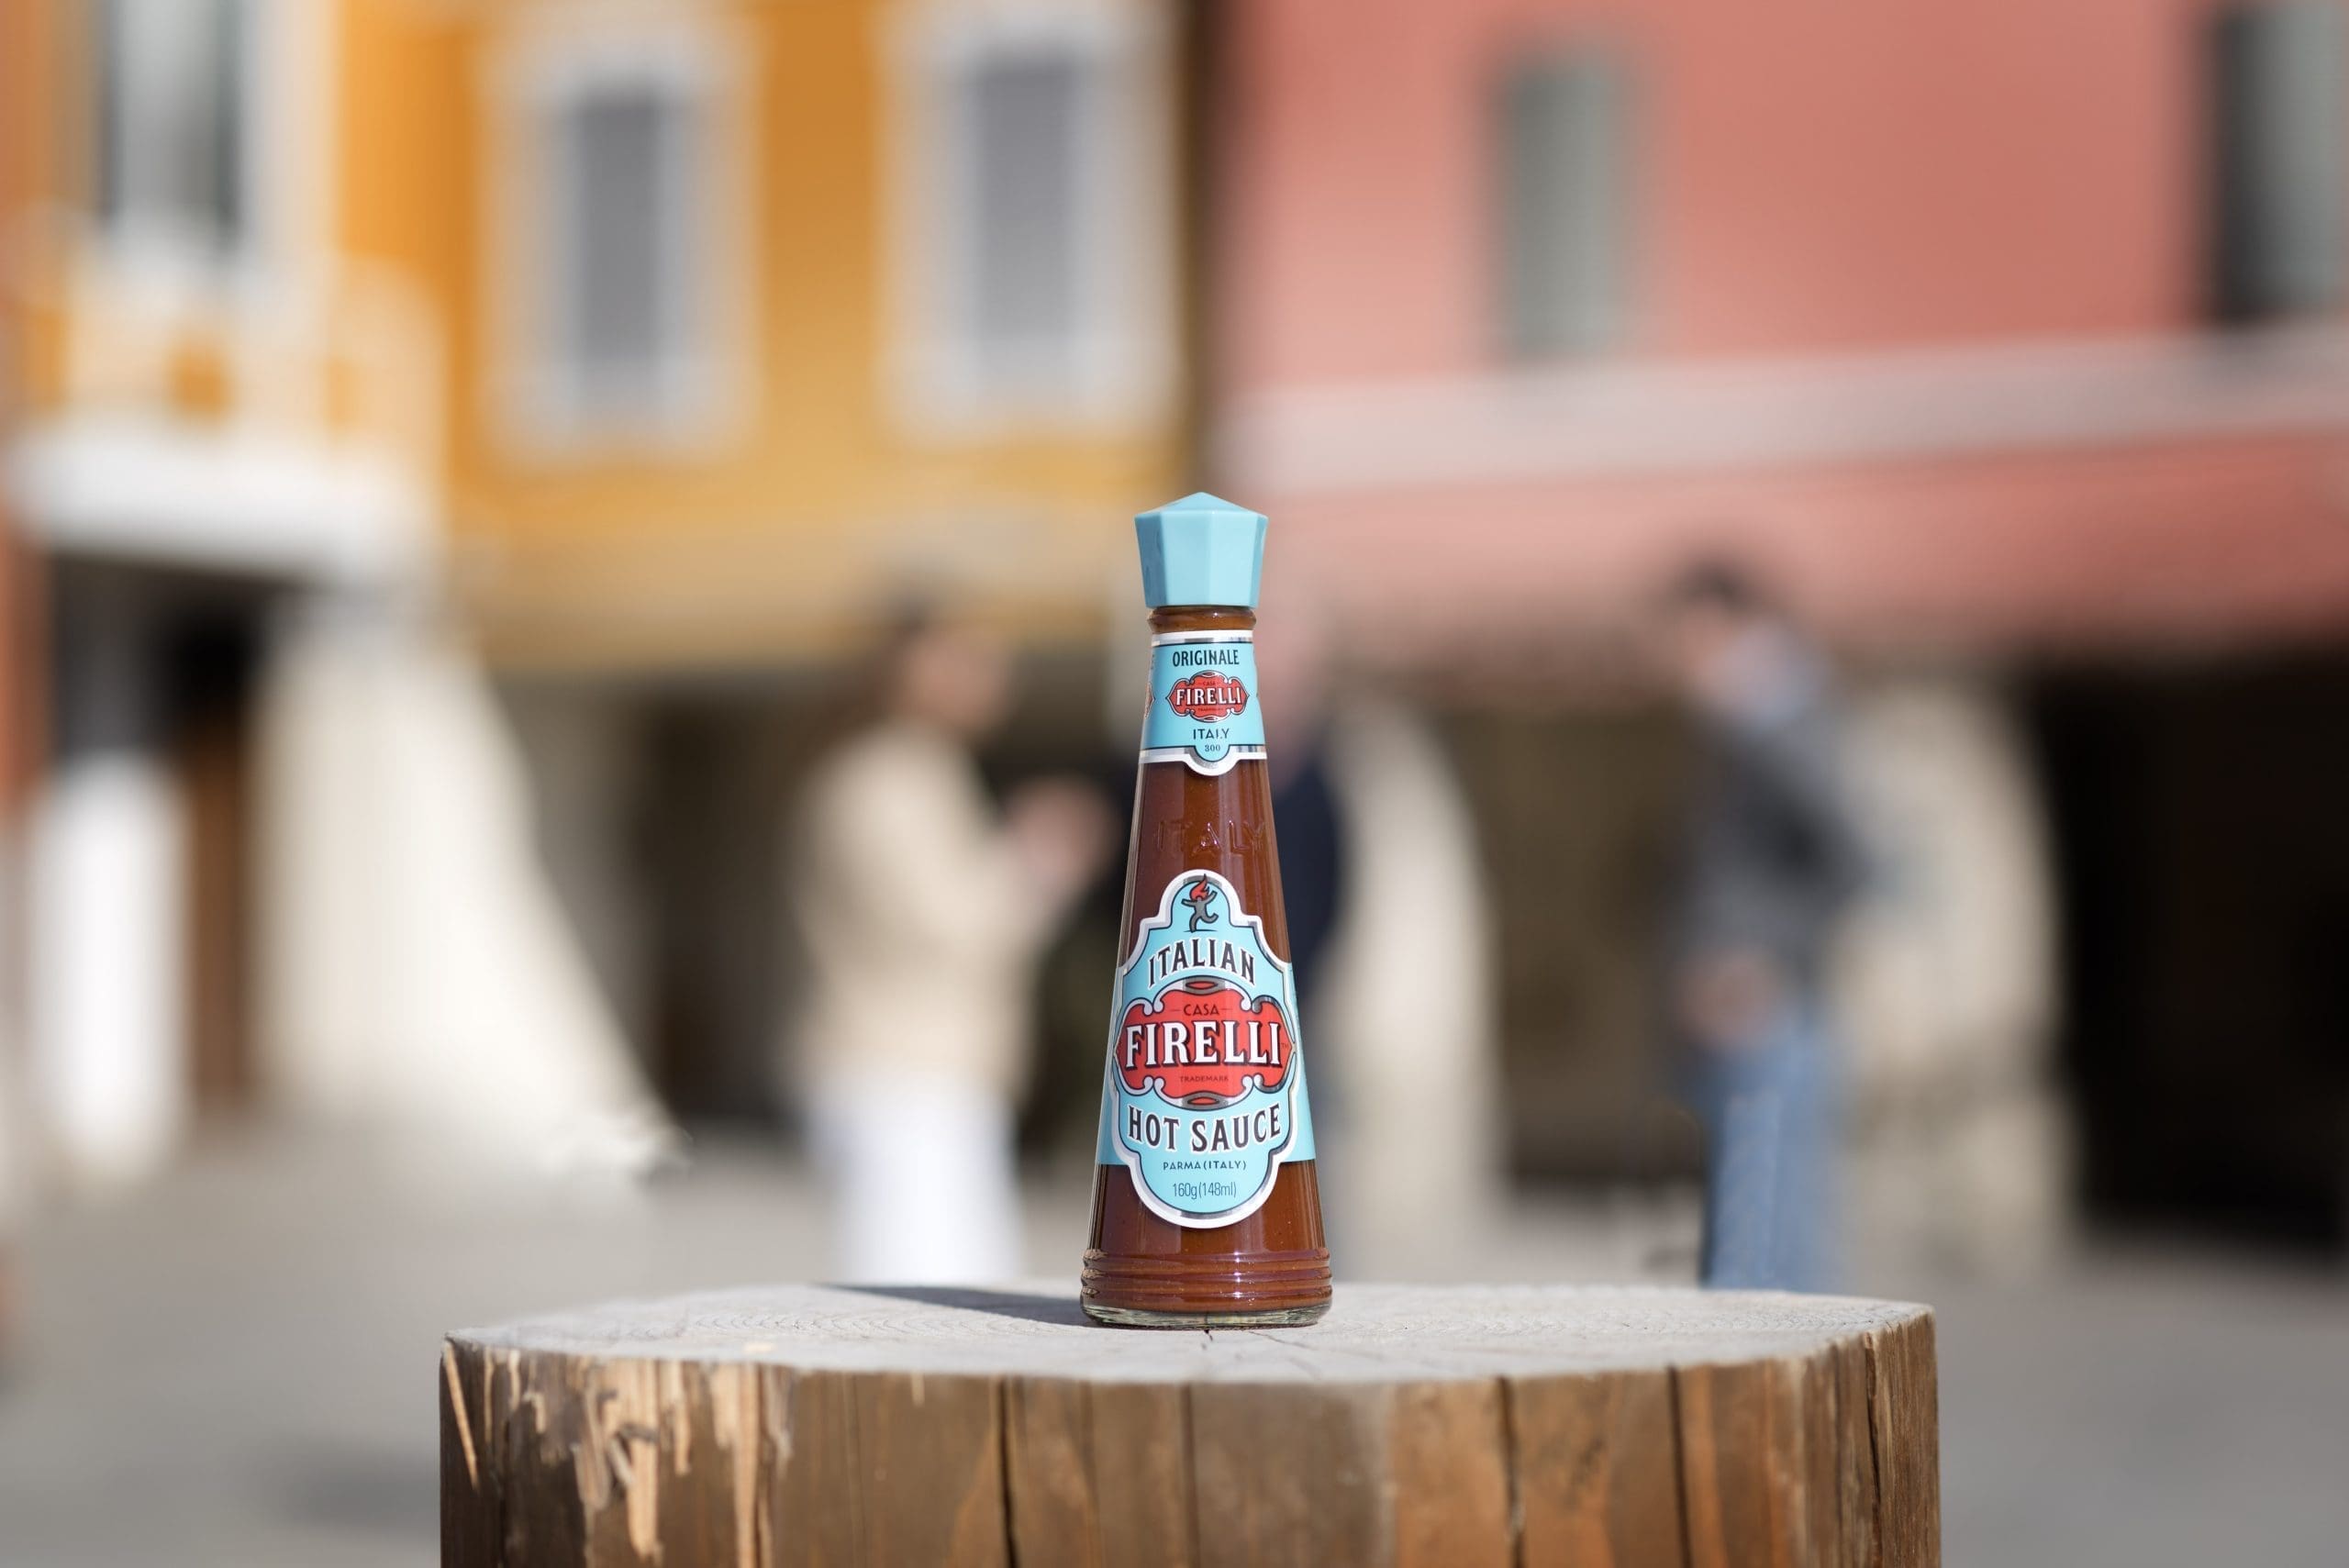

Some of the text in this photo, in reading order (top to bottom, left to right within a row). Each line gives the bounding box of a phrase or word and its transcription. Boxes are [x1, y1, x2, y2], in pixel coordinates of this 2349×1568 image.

[1173, 650, 1240, 667] ORIGINALE
[1175, 687, 1241, 706] FIRELLI
[1193, 728, 1230, 740] ITALY
[1147, 938, 1256, 987] ITALIAN
[1184, 1004, 1220, 1017] CASA
[1125, 1020, 1284, 1072] FIRELLI
[1128, 1104, 1281, 1151] HOT SAUCE
[1173, 1182, 1237, 1199] 160g(148ml)
